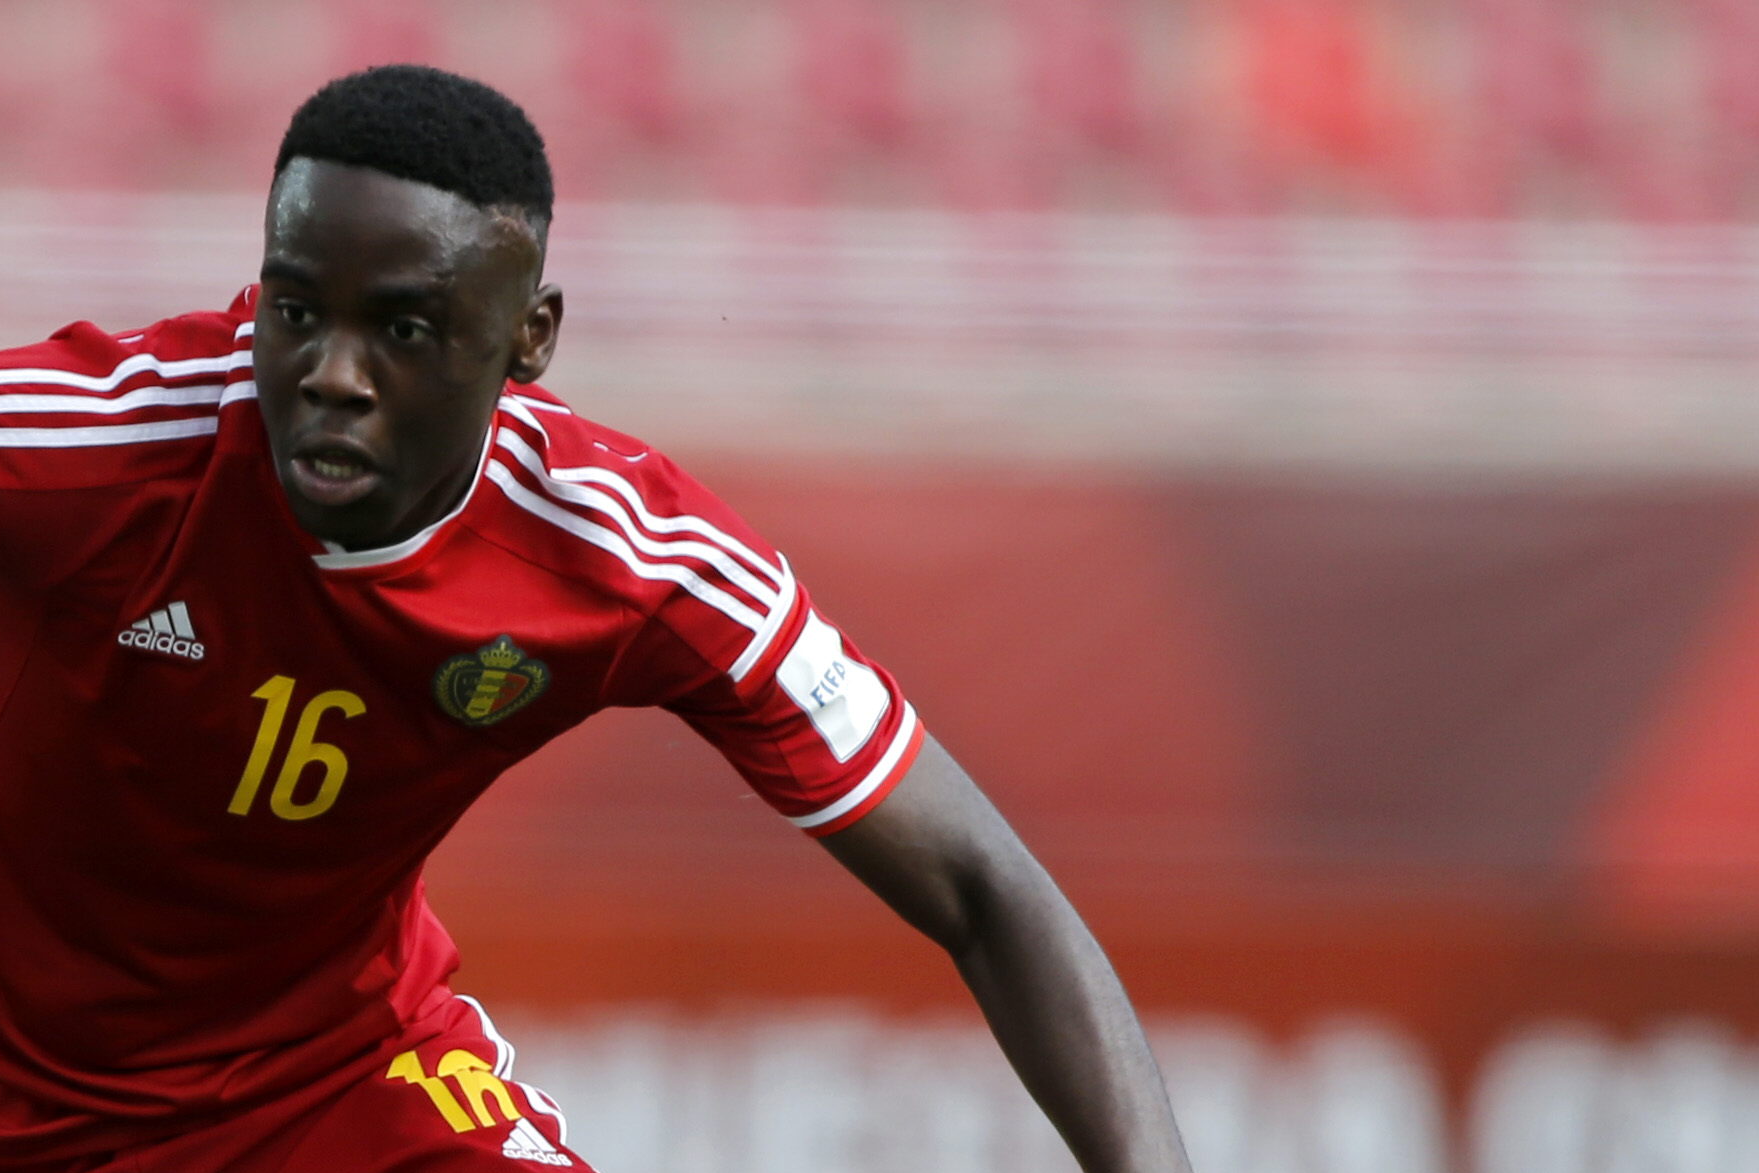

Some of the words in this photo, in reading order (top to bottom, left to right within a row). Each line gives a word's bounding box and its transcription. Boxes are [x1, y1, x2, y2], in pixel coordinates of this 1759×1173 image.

[118, 630, 205, 660] adidas
[810, 661, 846, 708] FIFA
[227, 675, 367, 821] 16
[502, 1149, 574, 1167] adidas
